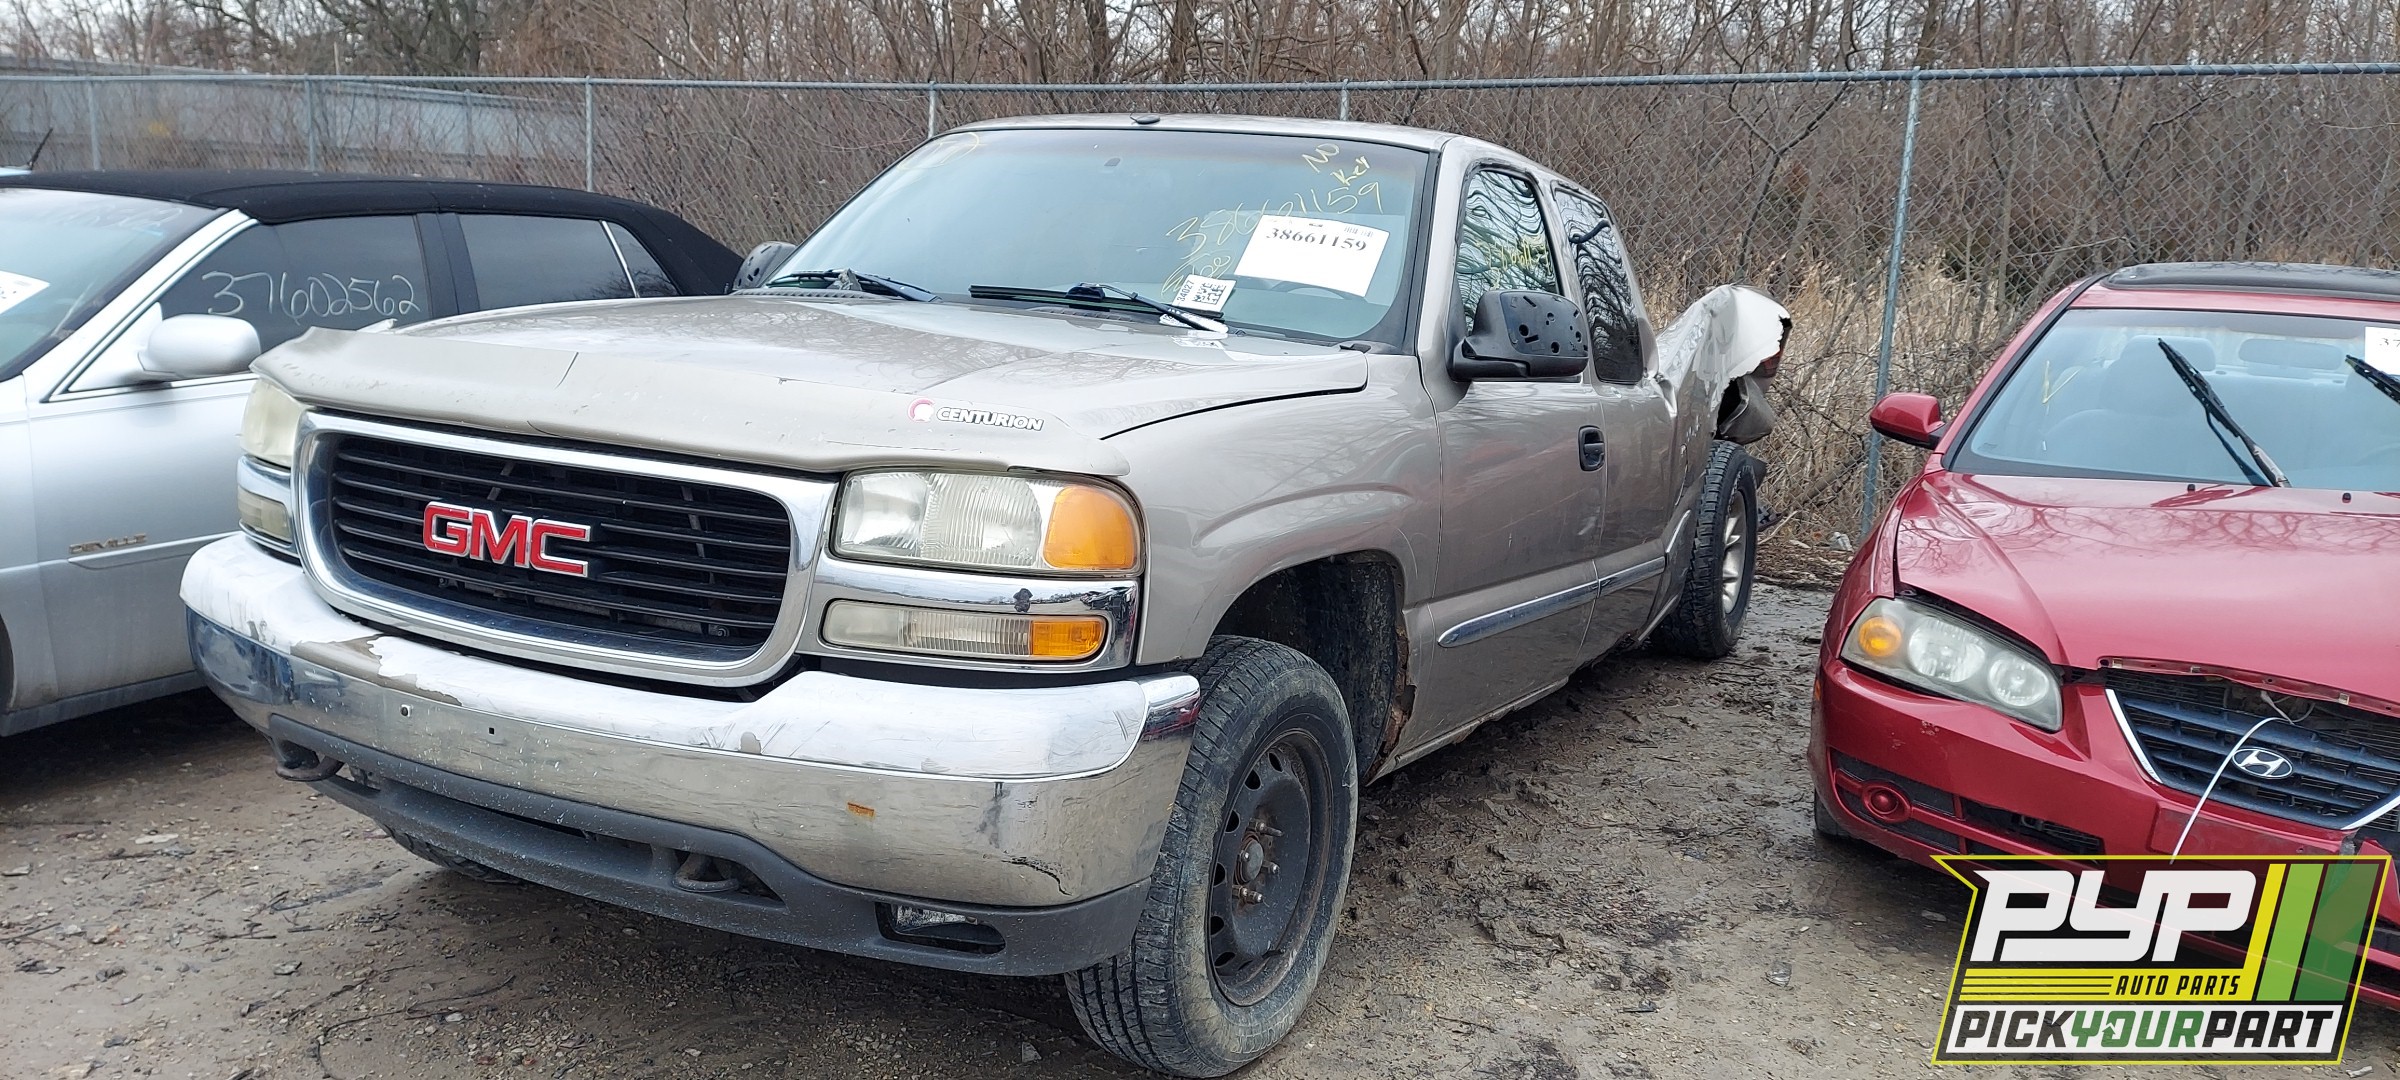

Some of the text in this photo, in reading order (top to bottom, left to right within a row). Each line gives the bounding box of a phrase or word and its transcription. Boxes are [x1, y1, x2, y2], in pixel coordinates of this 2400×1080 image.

[1266, 227, 1367, 251] 38661159
[202, 271, 421, 326] 37602562
[936, 406, 1044, 431] CENTURION
[423, 501, 592, 578] GMC
